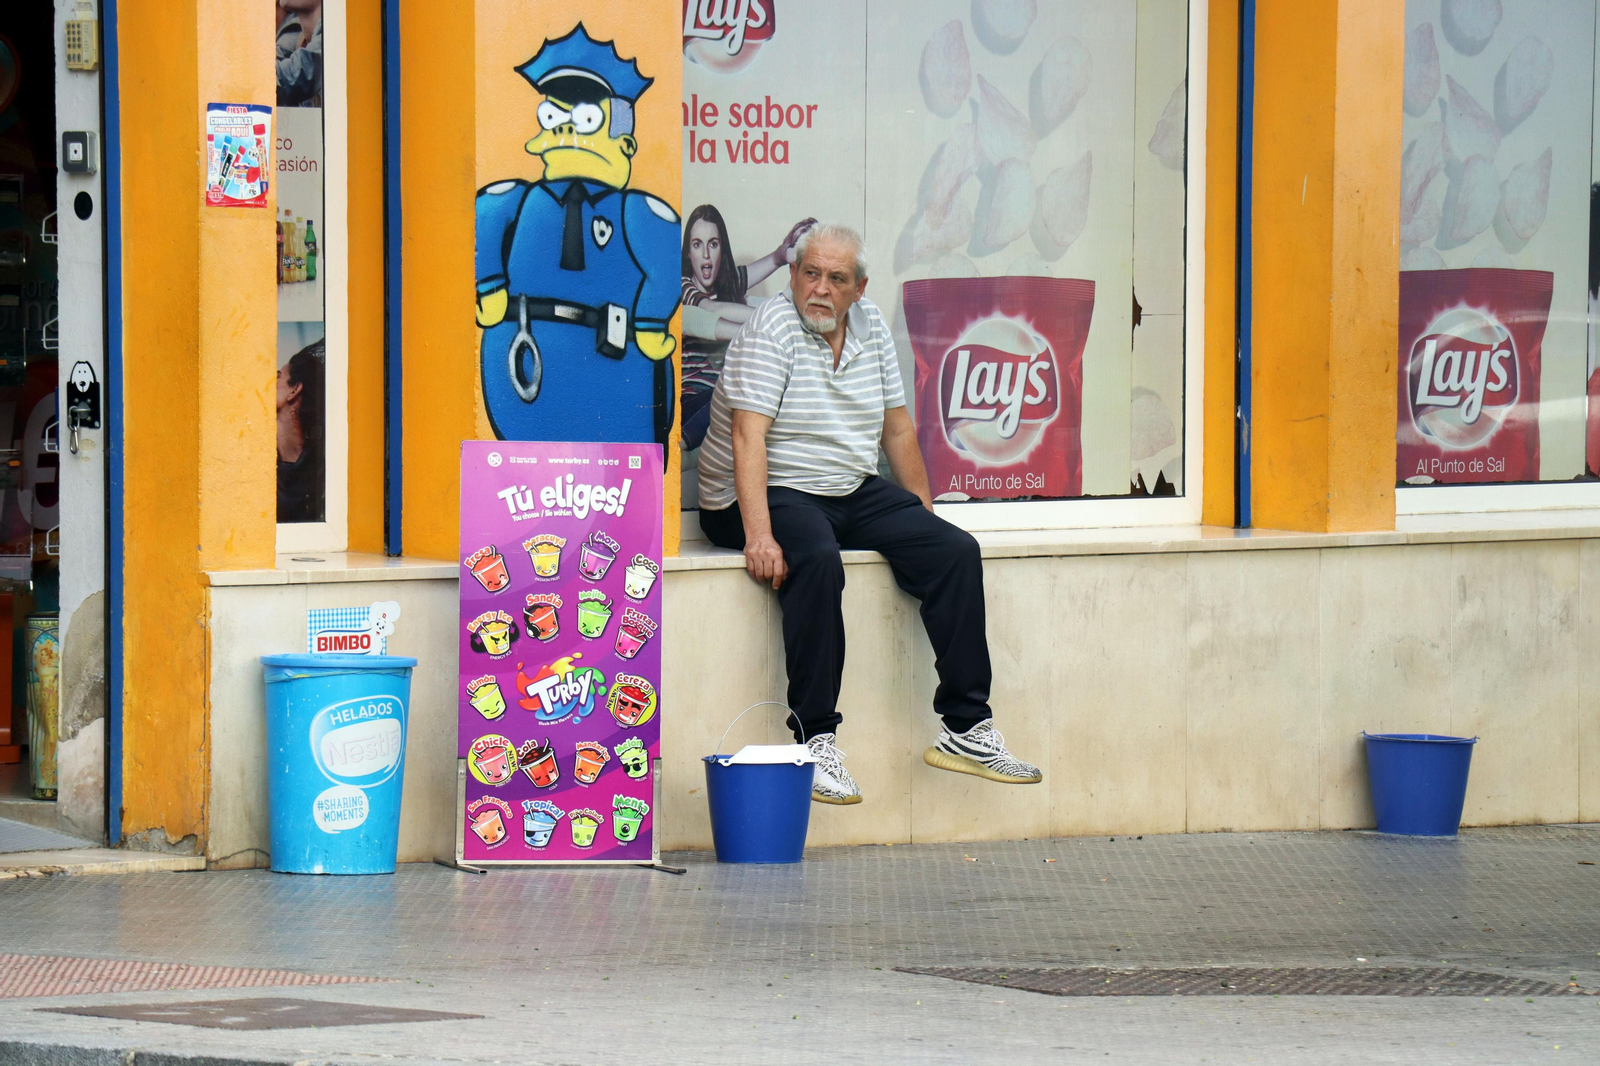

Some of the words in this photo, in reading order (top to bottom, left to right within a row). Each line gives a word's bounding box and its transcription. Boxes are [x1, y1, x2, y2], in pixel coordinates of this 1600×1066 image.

[683, 0, 768, 56] Lays
[226, 106, 248, 114] FIESTA
[729, 95, 818, 129] sabor
[231, 125, 249, 138] AQUÍ
[690, 130, 717, 164] la
[725, 130, 790, 164] vida
[276, 156, 318, 172] asión
[1416, 339, 1511, 425] Lay's
[948, 350, 1051, 440] Lay's
[1416, 458, 1428, 473] Al
[1431, 458, 1465, 473] Punto
[1468, 458, 1484, 472] de
[1487, 456, 1505, 472] Sal
[949, 474, 961, 490] Al
[965, 473, 1002, 490] Punto
[1005, 474, 1022, 490] de
[1025, 472, 1045, 489] Sal
[497, 485, 535, 515] Tú
[540, 473, 633, 520] eliges!
[511, 514, 523, 522] You
[523, 511, 540, 520] choose
[522, 534, 567, 552] Maracuyá
[594, 531, 620, 553] Mora
[464, 546, 492, 569] Fresa
[635, 553, 660, 573] Coco
[525, 593, 564, 609] Sandía
[578, 589, 607, 601] Mojito
[467, 610, 497, 633] Energy
[497, 610, 514, 624] Ice
[621, 615, 654, 639] Bosque
[626, 607, 659, 631] Frutas
[317, 633, 371, 652] BIMBO
[466, 674, 496, 692] Limón
[615, 672, 651, 692] Cereza
[329, 702, 393, 726] HELADOS
[473, 736, 510, 752] Chicle
[516, 739, 538, 759] Cola
[576, 741, 611, 761] Mandarina
[614, 736, 643, 756] Melón
[316, 795, 363, 811] #SHARING
[467, 799, 483, 813] San
[482, 795, 514, 819] Francisco
[521, 799, 566, 820] Tropical
[612, 794, 650, 816] Menta
[323, 807, 365, 823] MOMENTS
